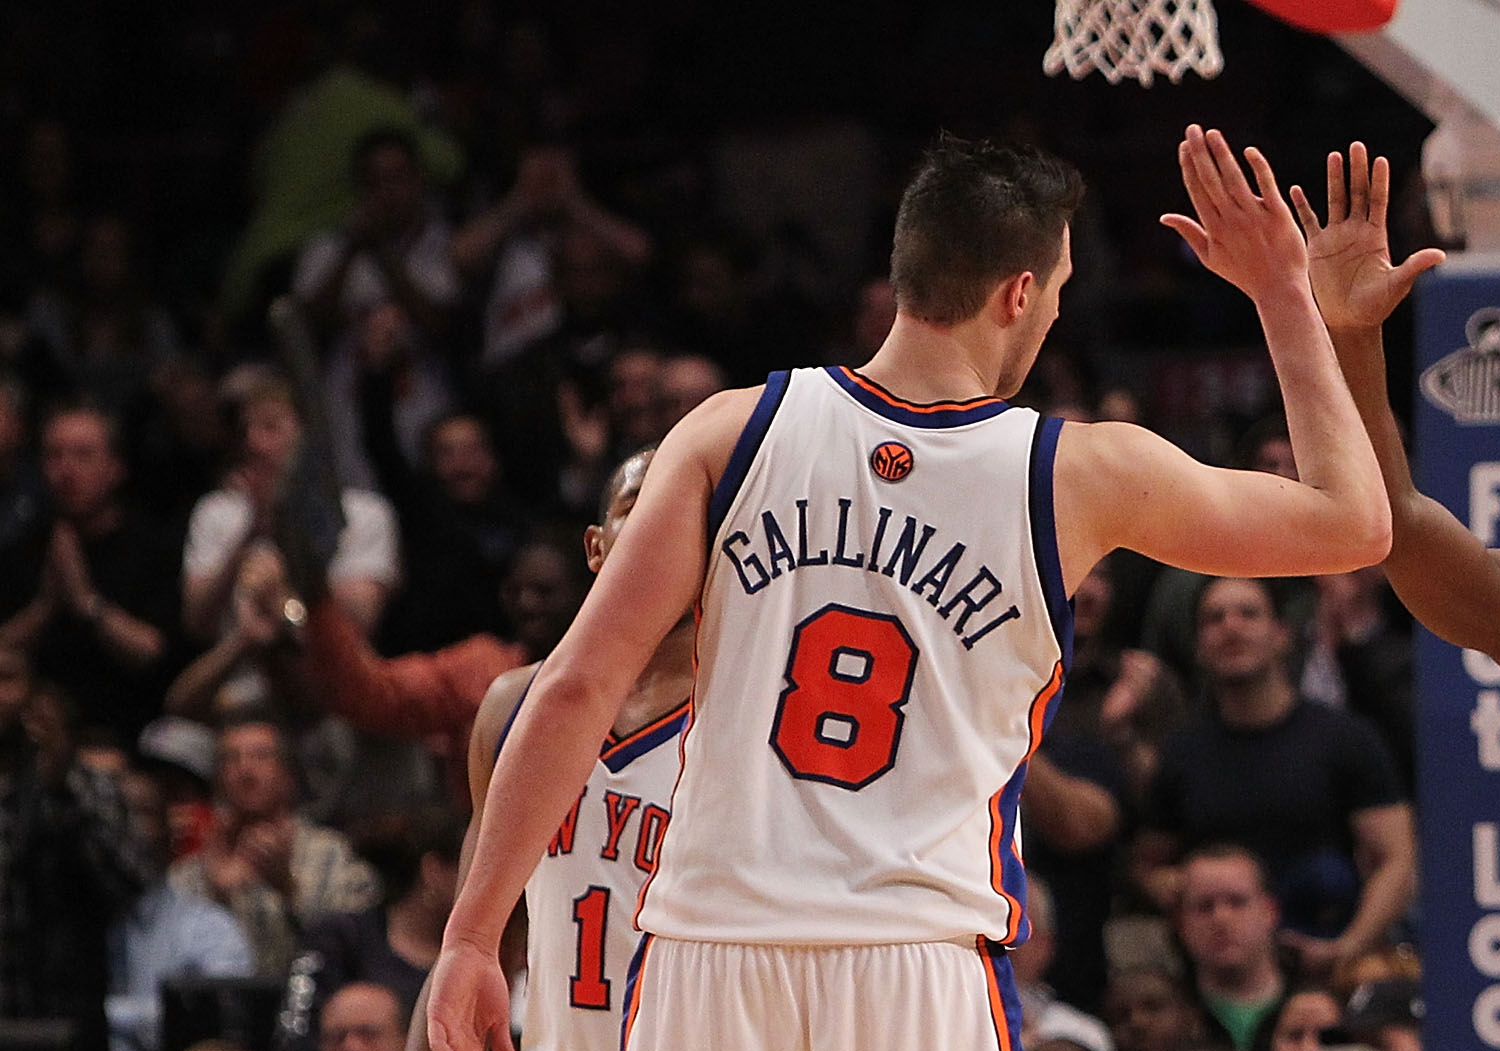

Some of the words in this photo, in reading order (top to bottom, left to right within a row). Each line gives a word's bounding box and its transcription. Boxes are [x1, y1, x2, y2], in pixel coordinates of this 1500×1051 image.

[721, 498, 1021, 651] GALLINARI
[767, 602, 920, 792] 8
[569, 884, 612, 1012] 1
